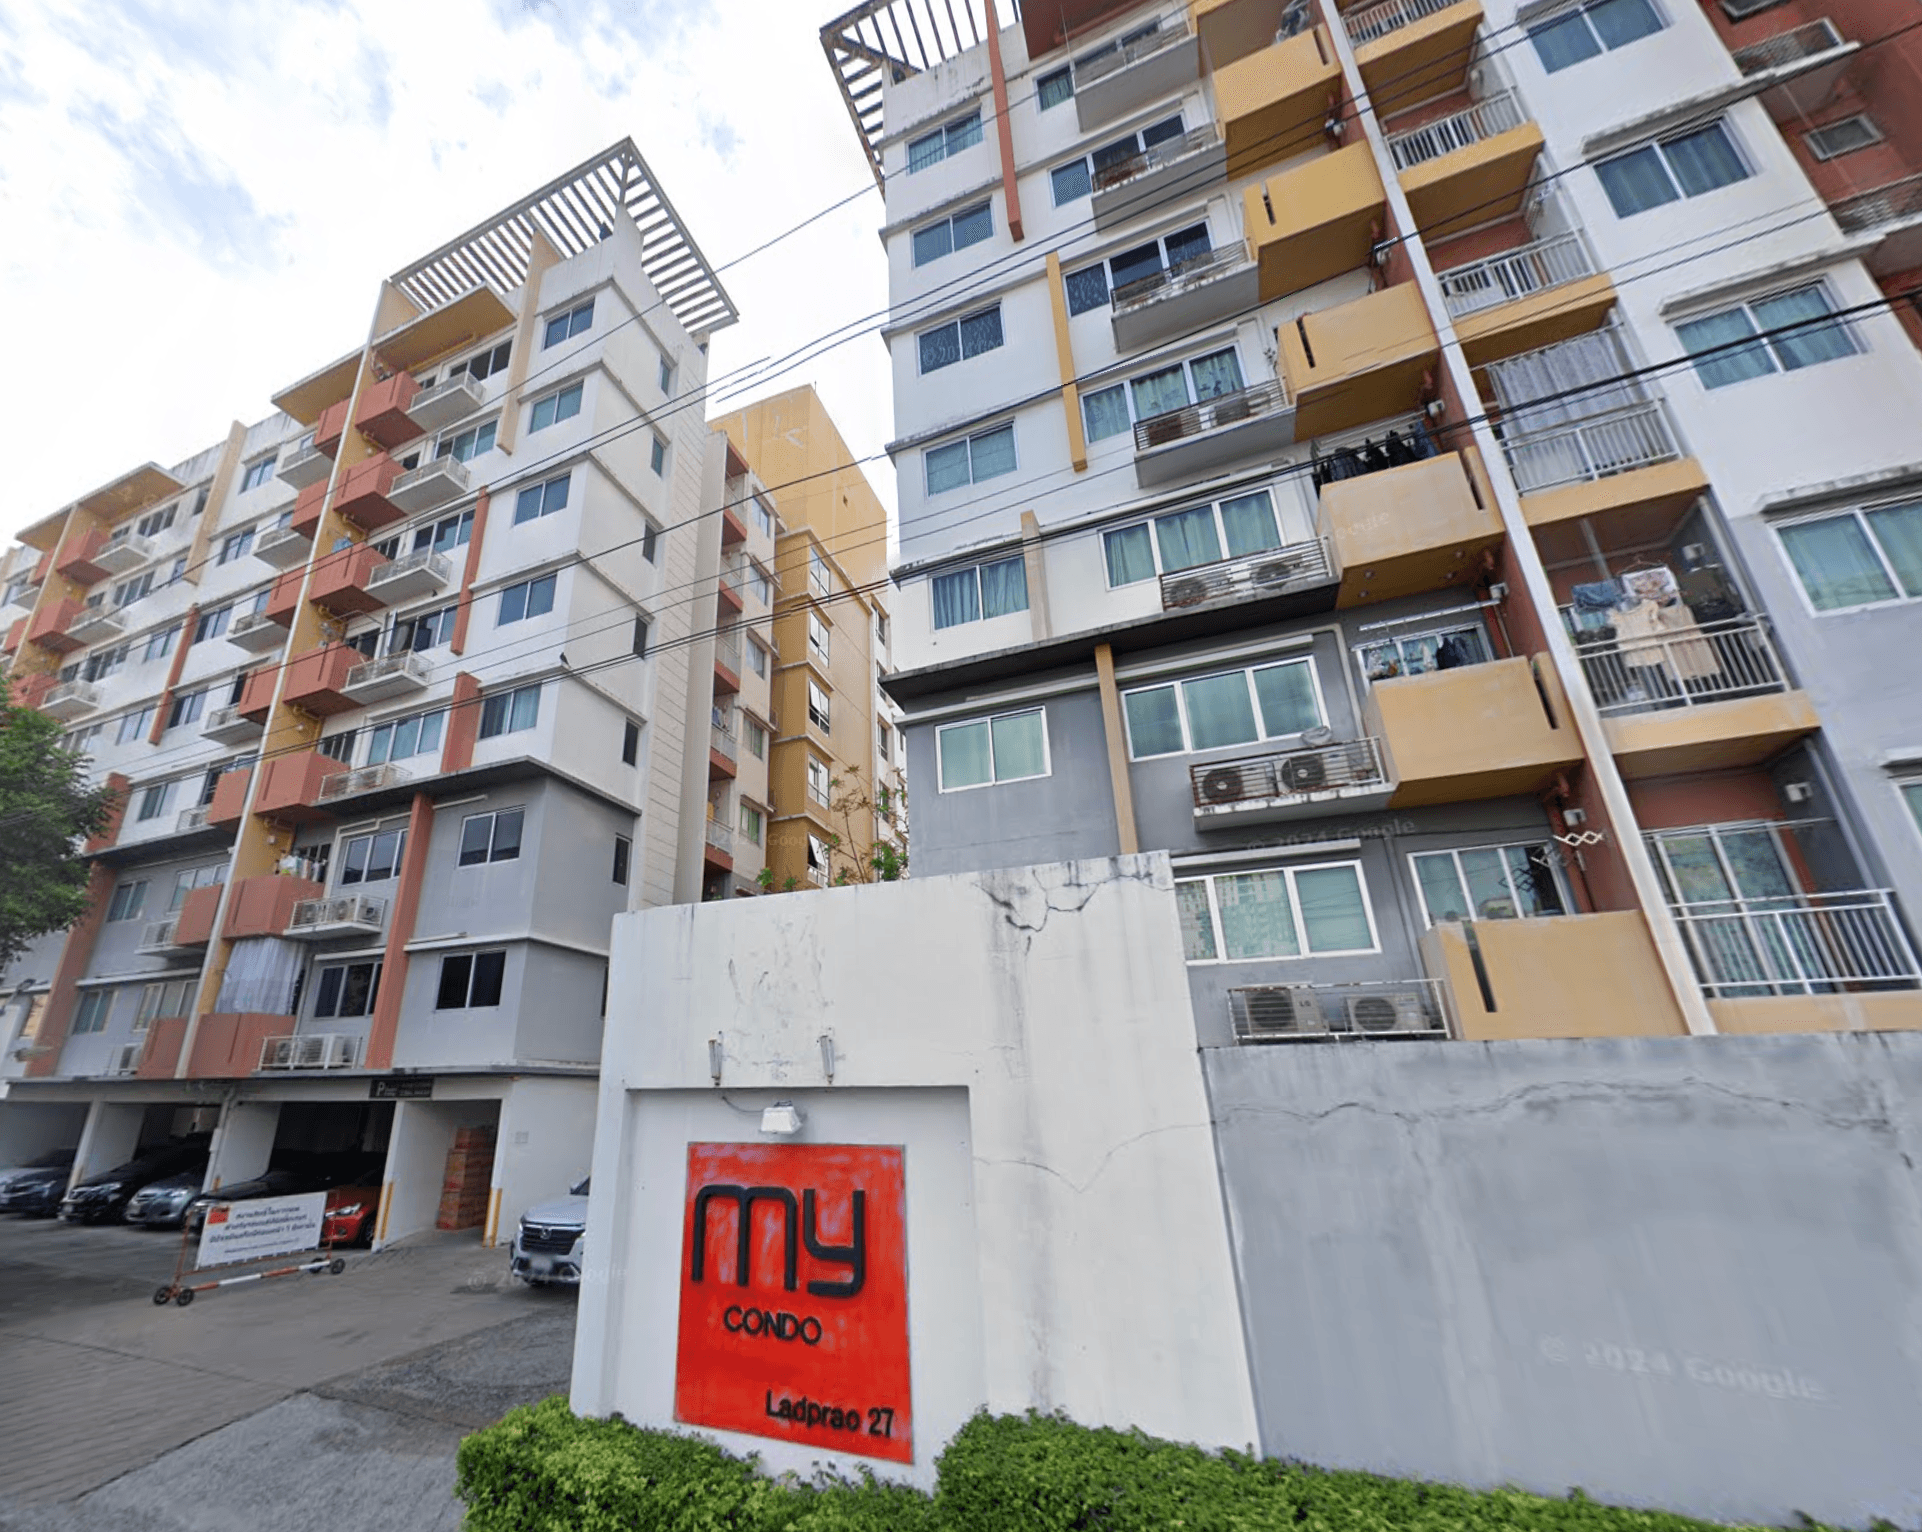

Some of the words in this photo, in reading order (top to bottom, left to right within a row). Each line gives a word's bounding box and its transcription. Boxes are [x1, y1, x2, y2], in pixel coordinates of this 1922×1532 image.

[723, 1304, 823, 1345] CONDO
[765, 1389, 860, 1431] Ladprao
[867, 1407, 895, 1438] 27
